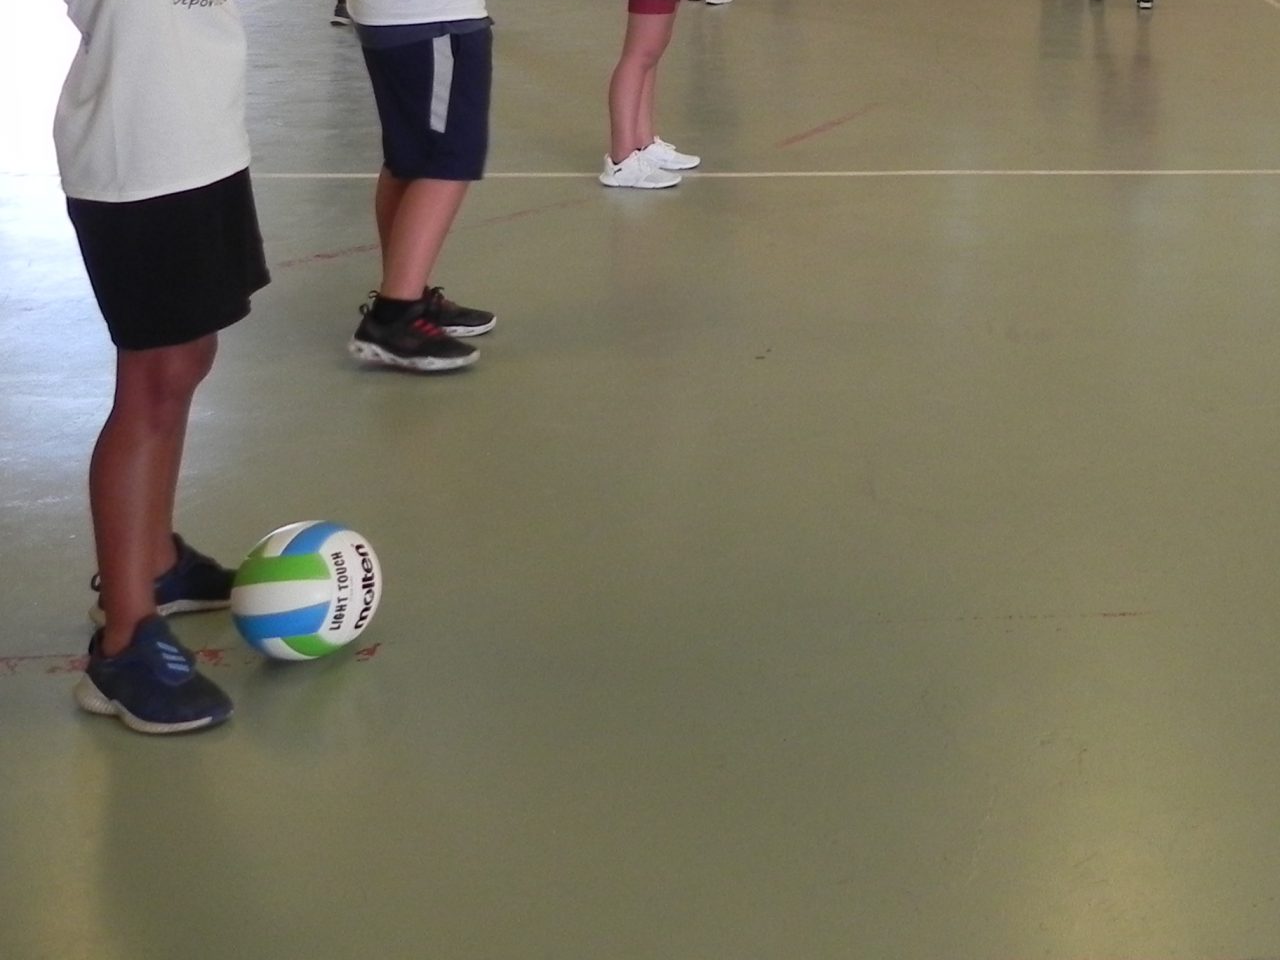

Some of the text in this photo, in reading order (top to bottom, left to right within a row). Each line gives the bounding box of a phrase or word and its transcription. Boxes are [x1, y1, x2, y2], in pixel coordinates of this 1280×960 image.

[329, 551, 349, 631] LIGHT TOUCH
[354, 543, 375, 630] molten
